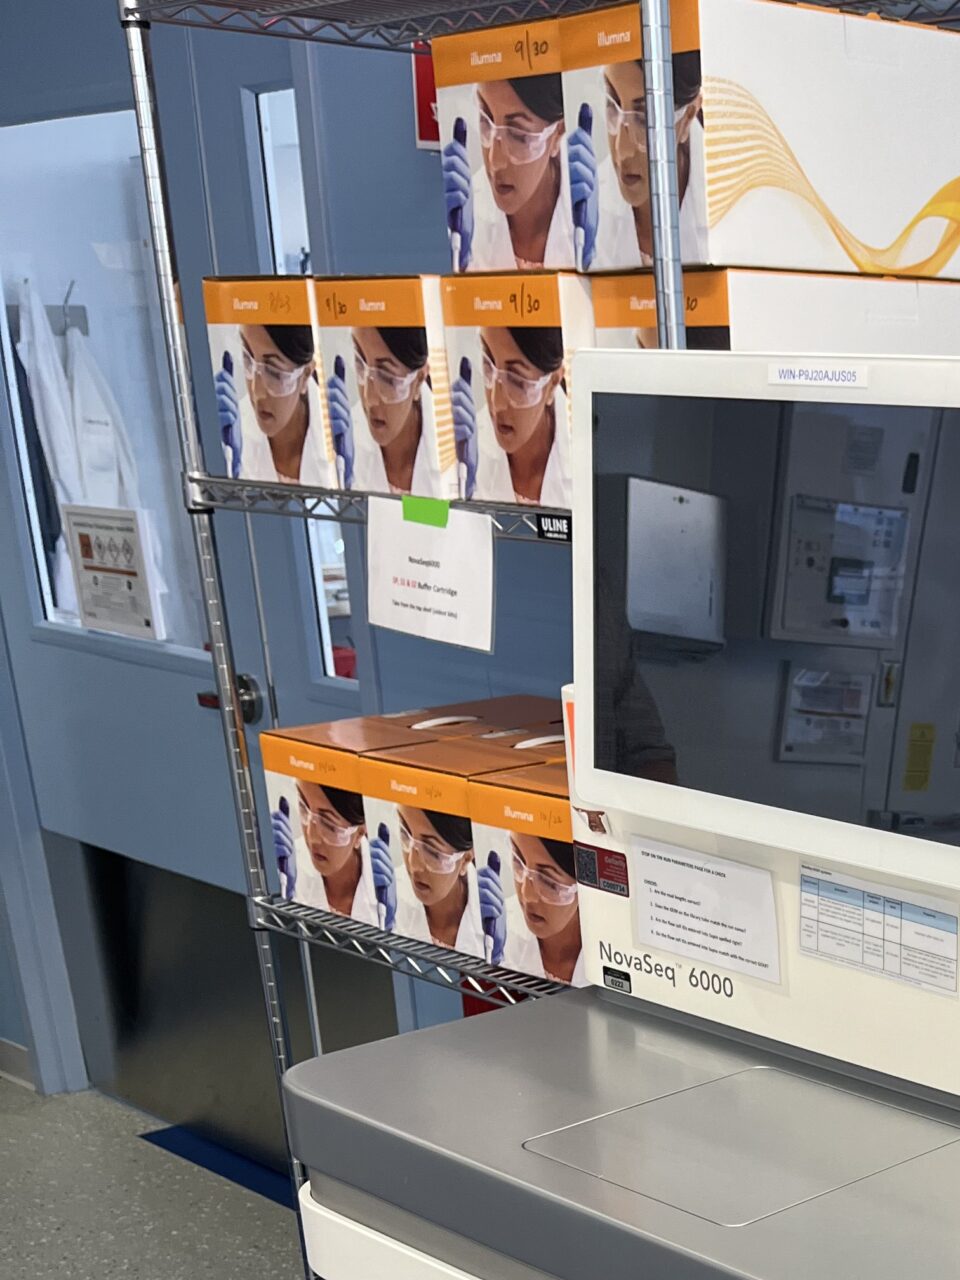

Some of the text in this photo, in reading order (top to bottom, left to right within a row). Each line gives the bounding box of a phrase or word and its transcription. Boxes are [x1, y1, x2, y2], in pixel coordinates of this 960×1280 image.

[597, 31, 631, 47] illumina
[514, 29, 549, 71] 9/30
[470, 52, 503, 66] illumina
[232, 297, 259, 311] illumina
[359, 298, 386, 312] illumina
[473, 296, 503, 311] illumina
[508, 282, 541, 318] 9/30
[778, 368, 857, 383] WIN-P9J20AJUS05
[541, 517, 568, 533] ULINE
[433, 585, 458, 597] Cartridge
[289, 755, 315, 772] illumina
[390, 779, 417, 796] illumina
[503, 805, 534, 823] illumina
[599, 940, 734, 998] NovaSeq 6000
